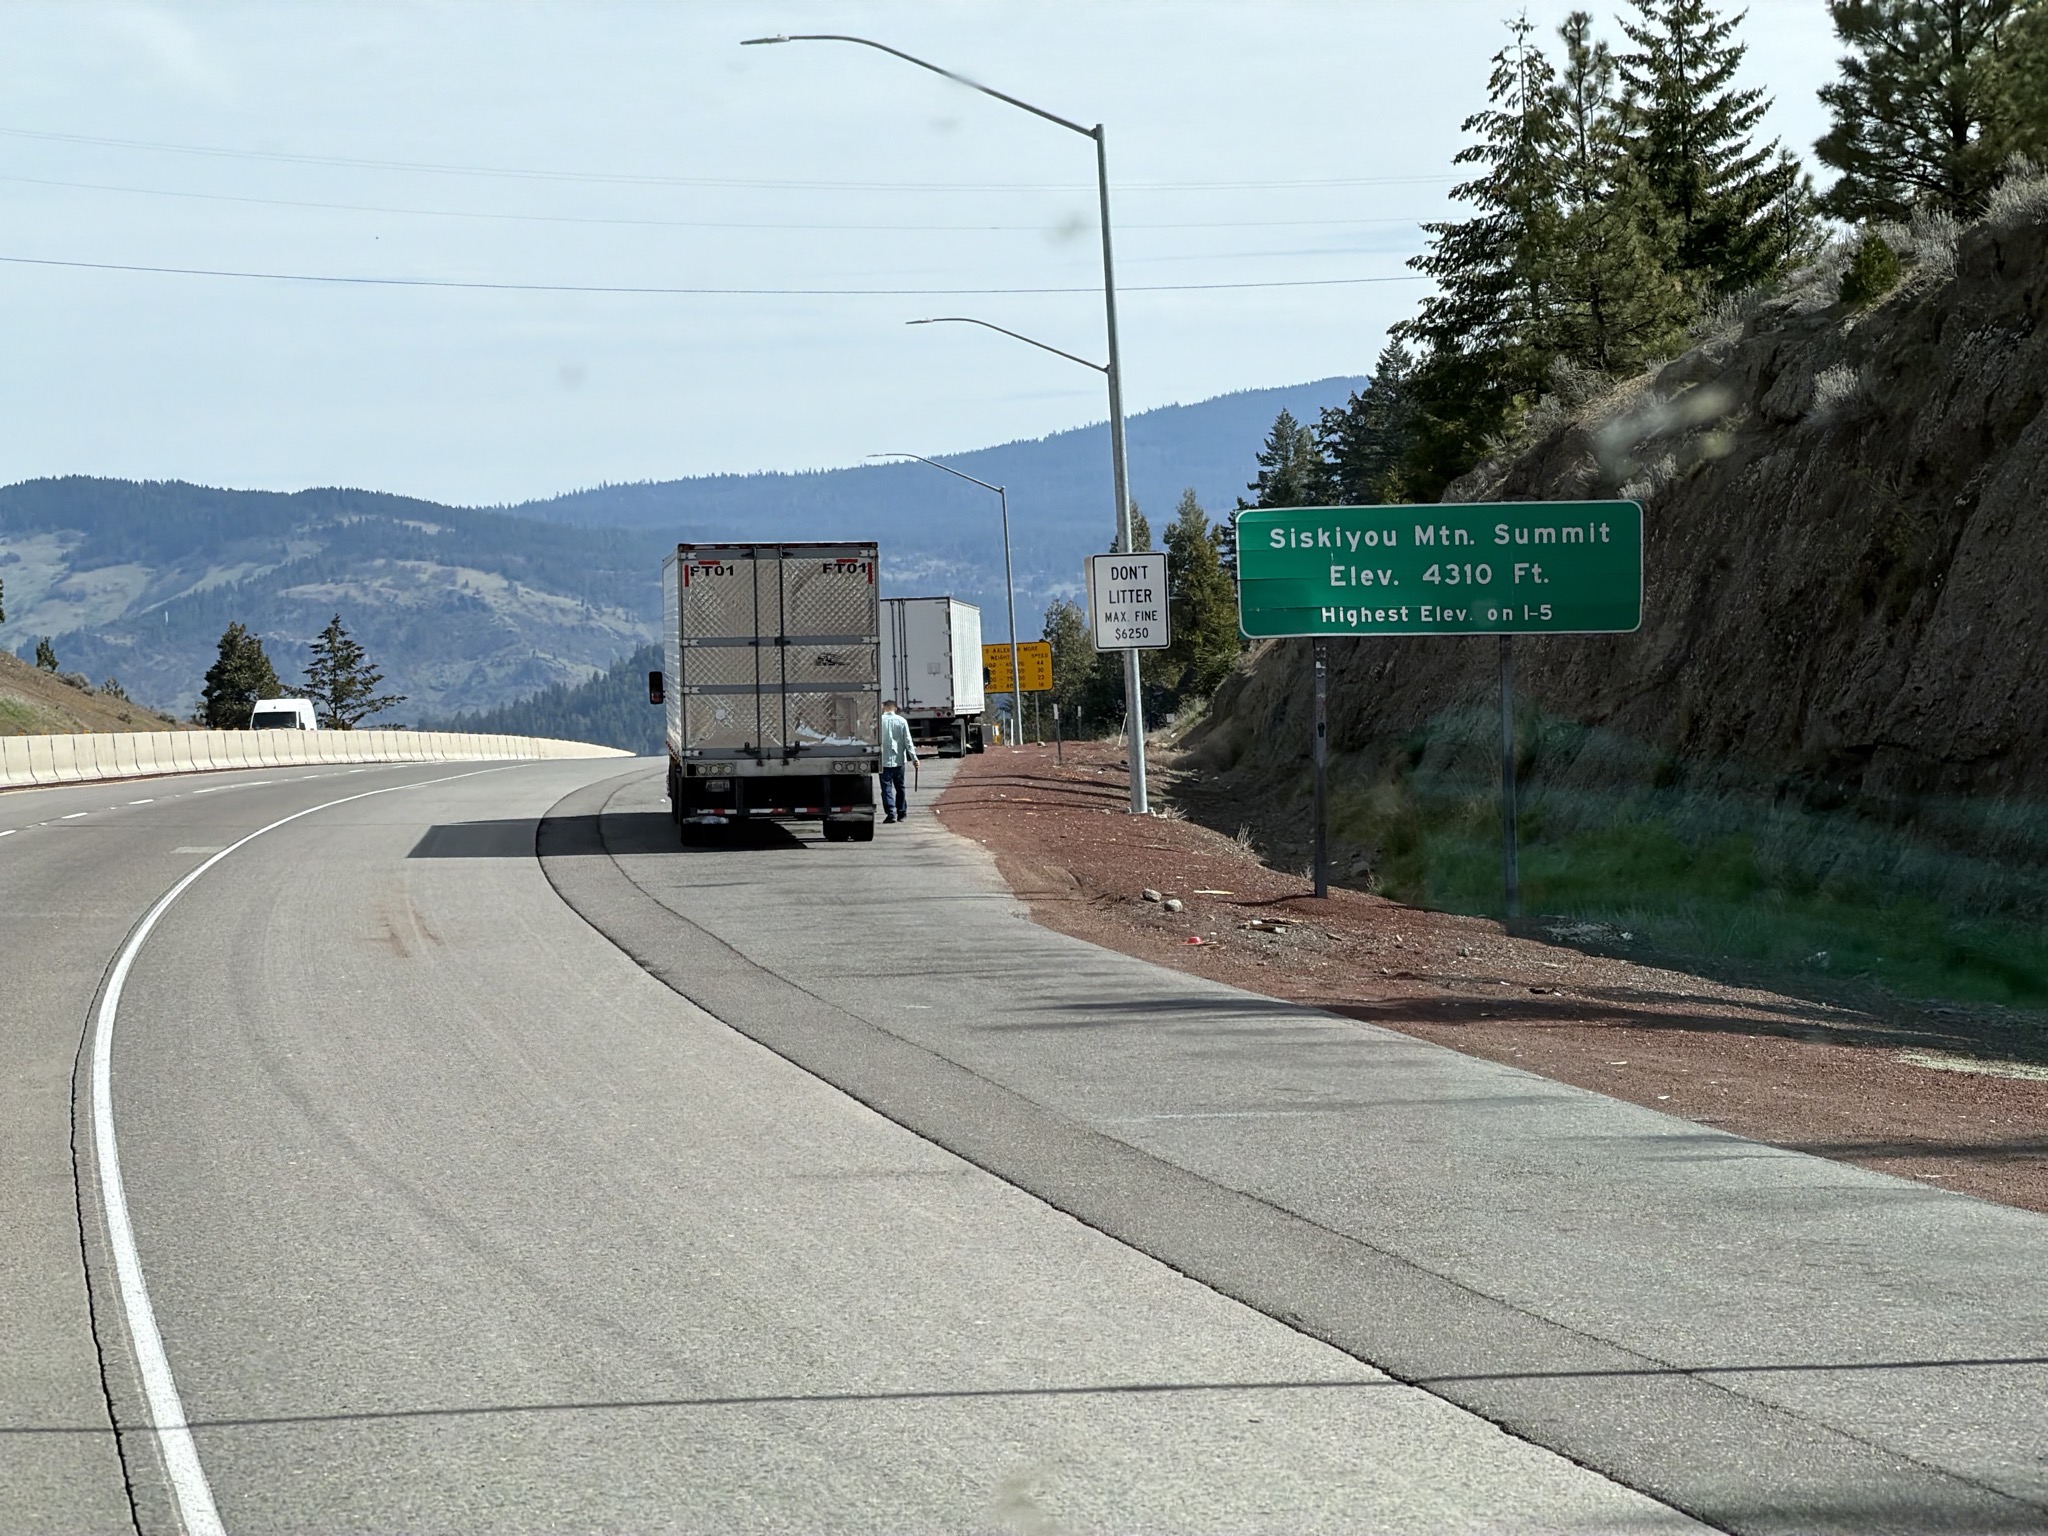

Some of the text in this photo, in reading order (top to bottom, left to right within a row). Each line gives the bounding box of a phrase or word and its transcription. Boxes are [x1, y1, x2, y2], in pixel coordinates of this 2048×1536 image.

[1269, 522, 1611, 553] Siskiyou Mtn. Summit
[690, 565, 734, 577] FT01
[822, 563, 867, 574] FT01
[1111, 566, 1148, 580] DON'T
[1330, 561, 1550, 587] Elev. 4310 Ft.
[1109, 589, 1152, 604] LITTER
[1105, 610, 1158, 623] MAX. FINE
[1321, 604, 1553, 628] Highest Elev. on I-5
[1115, 628, 1149, 641] $6250
